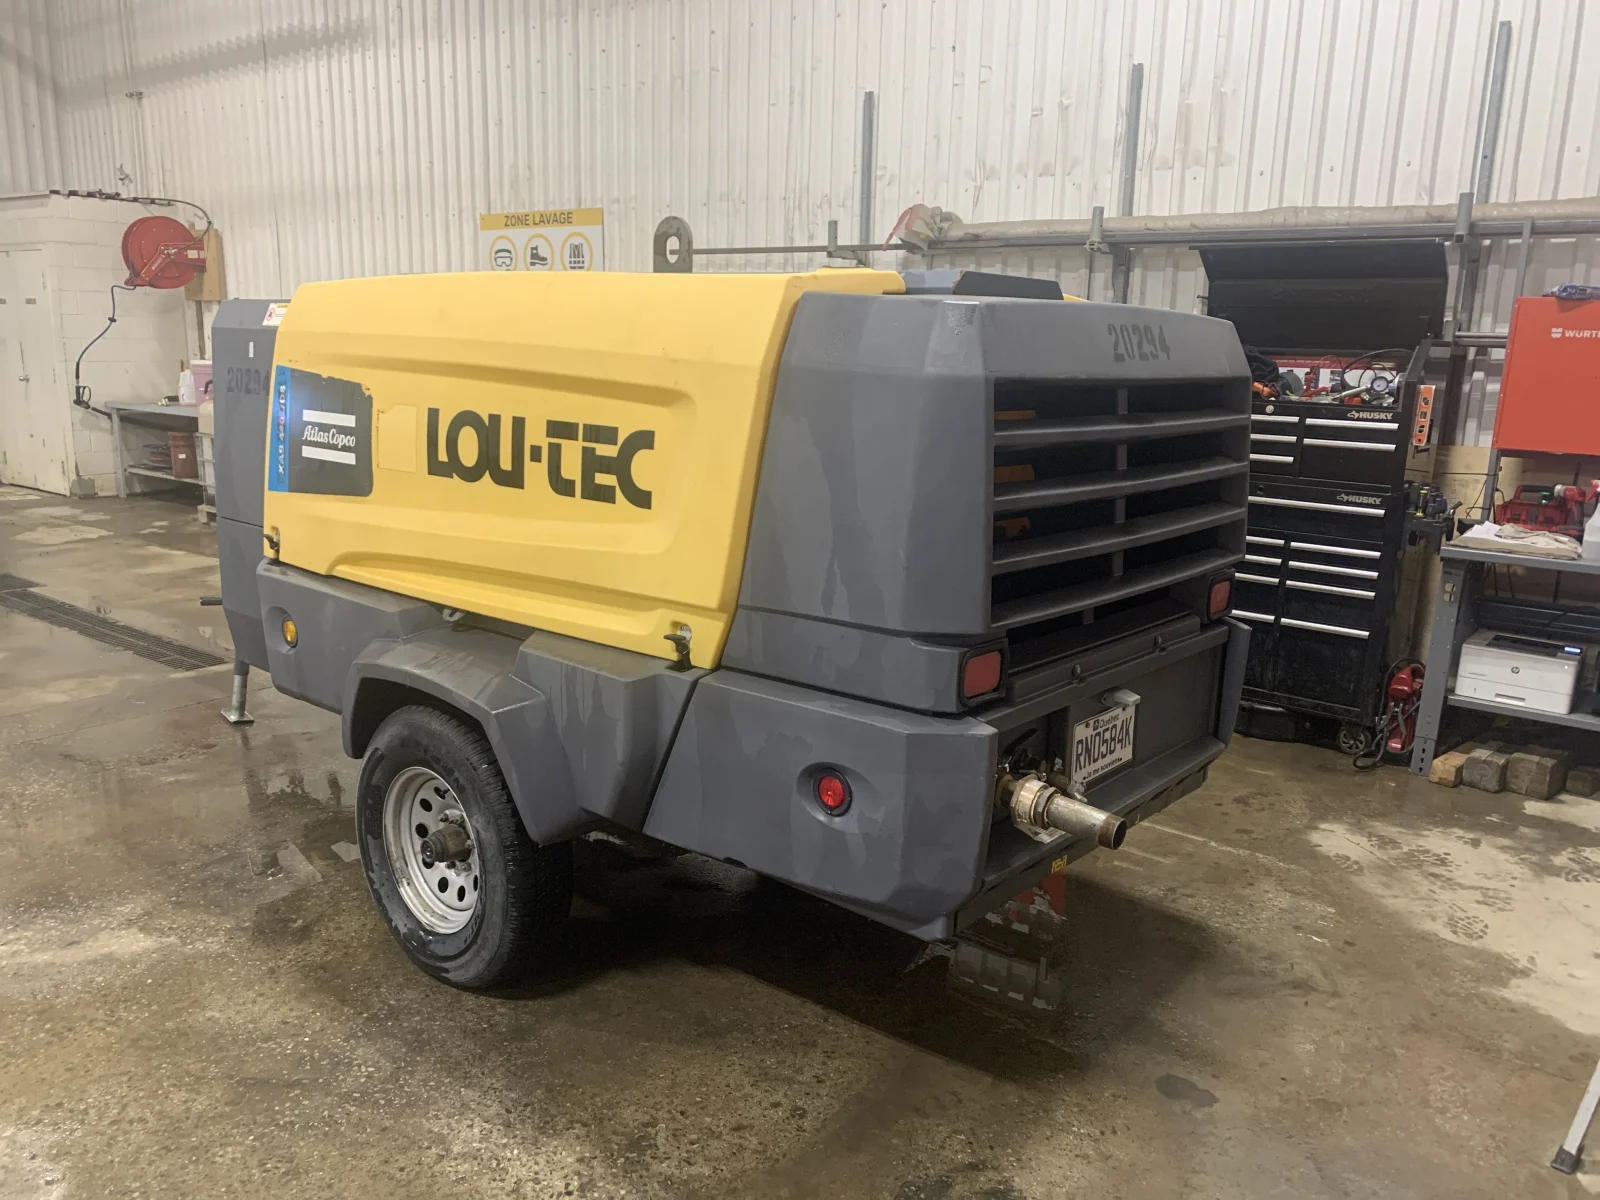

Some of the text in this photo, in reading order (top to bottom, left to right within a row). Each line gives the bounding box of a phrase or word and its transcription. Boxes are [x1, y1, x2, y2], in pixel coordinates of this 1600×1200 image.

[504, 211, 574, 227] ZONE LAVAGE
[1107, 323, 1171, 362] 20294
[1359, 411, 1394, 420] HUSKY
[302, 425, 356, 448] Atlas Copco
[427, 407, 655, 510] LOU-TEC
[1348, 495, 1382, 505] HUSKY
